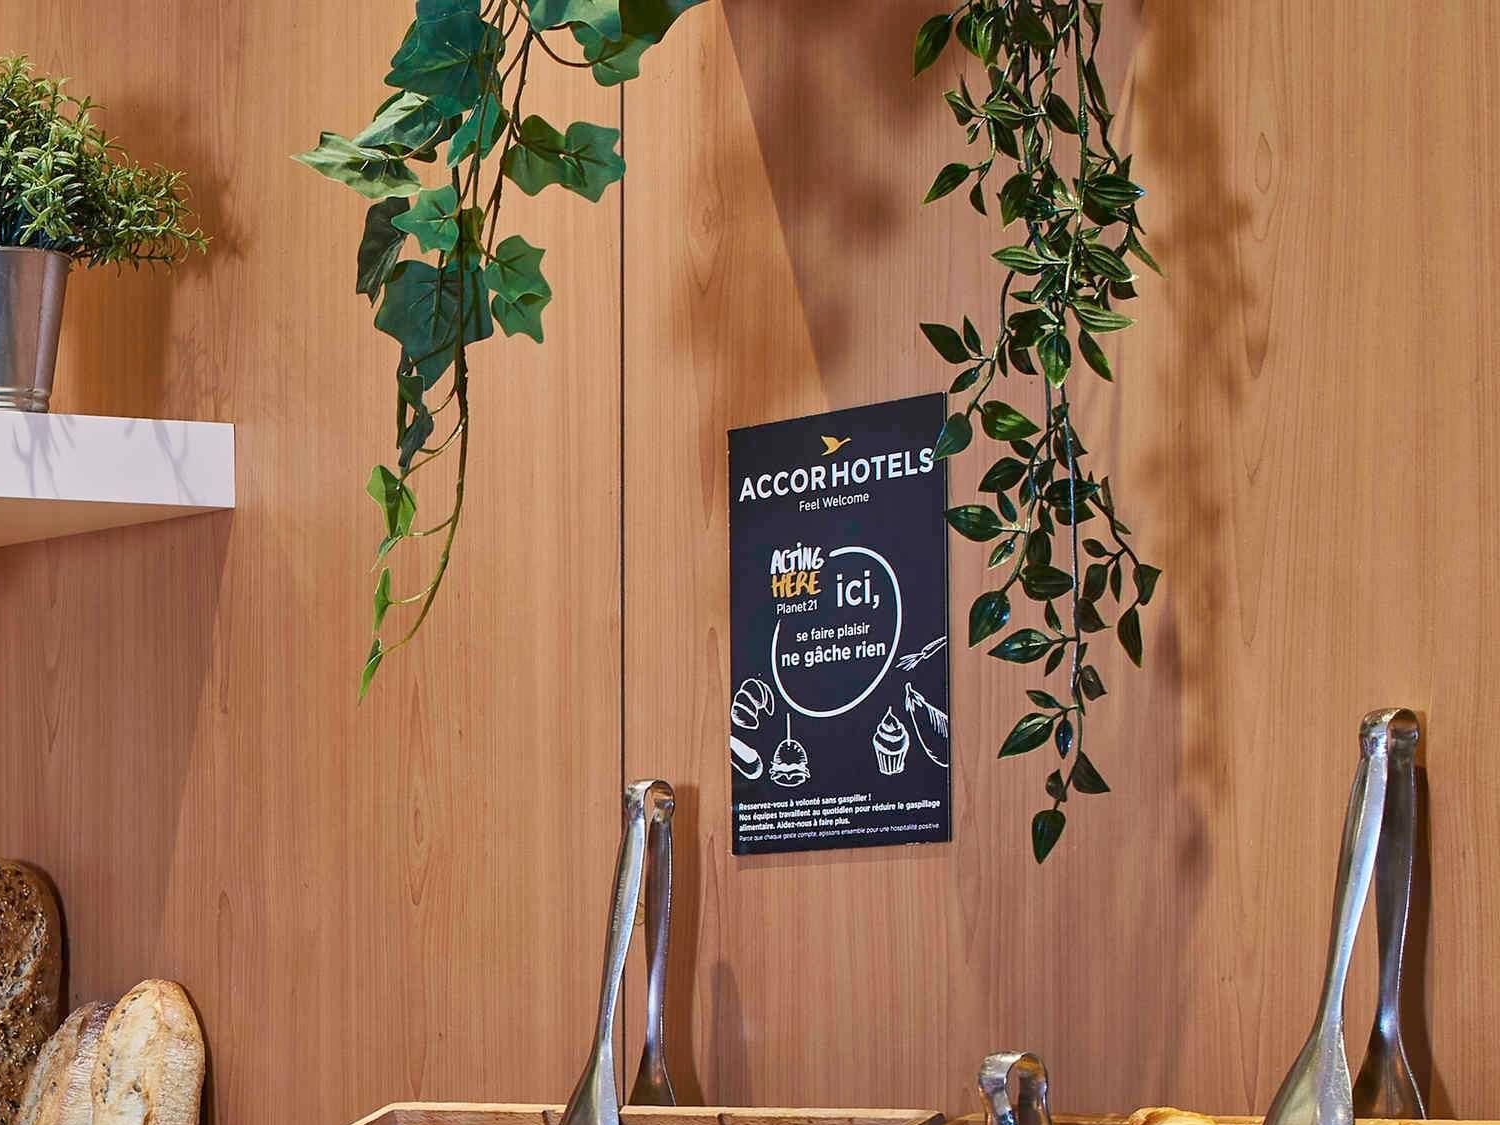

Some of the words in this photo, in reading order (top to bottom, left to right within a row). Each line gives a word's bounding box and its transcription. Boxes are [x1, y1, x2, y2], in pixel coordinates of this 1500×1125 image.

[799, 499, 821, 512] Feel
[823, 492, 870, 508] Welcome
[771, 570, 822, 598] HERE
[836, 570, 880, 609] ici,
[796, 631, 809, 642] se
[811, 627, 835, 640] faire
[837, 622, 871, 638] plaisir
[781, 653, 800, 667] ne
[804, 646, 852, 668] gâche
[855, 641, 886, 659] rien
